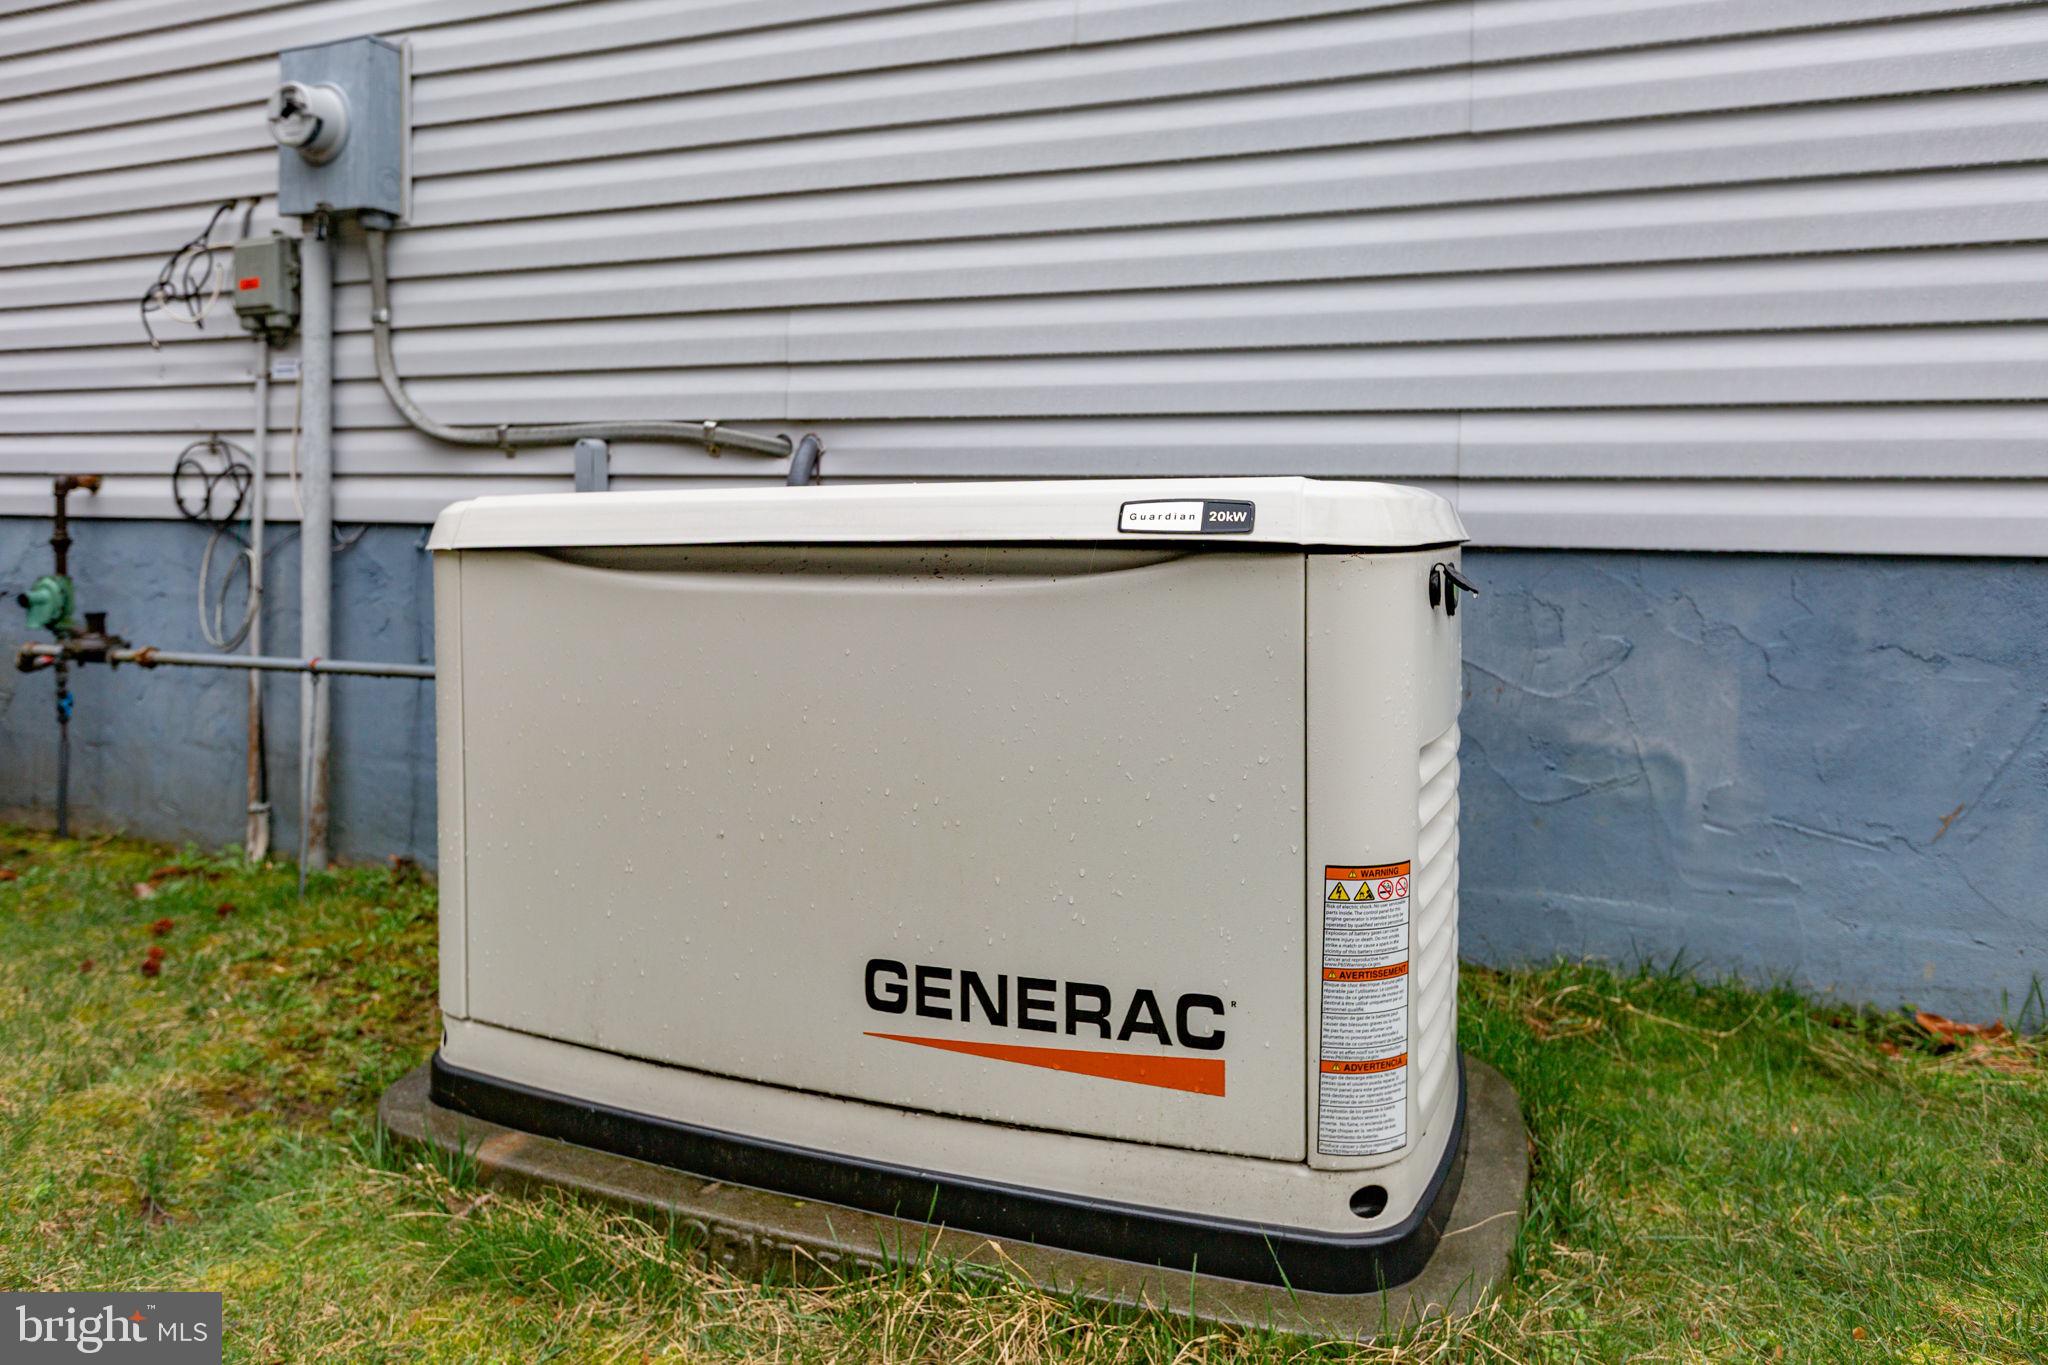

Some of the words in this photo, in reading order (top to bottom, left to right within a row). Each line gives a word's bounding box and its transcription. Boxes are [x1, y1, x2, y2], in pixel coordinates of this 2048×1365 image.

[1130, 512, 1196, 521] Guardian
[1209, 510, 1248, 522] 20kW
[1361, 867, 1399, 877] WARNING
[1339, 965, 1406, 979] AVERTISSEMENT
[865, 958, 1225, 1050] GENERAC
[1344, 1058, 1402, 1071] ADVERTENCIA
